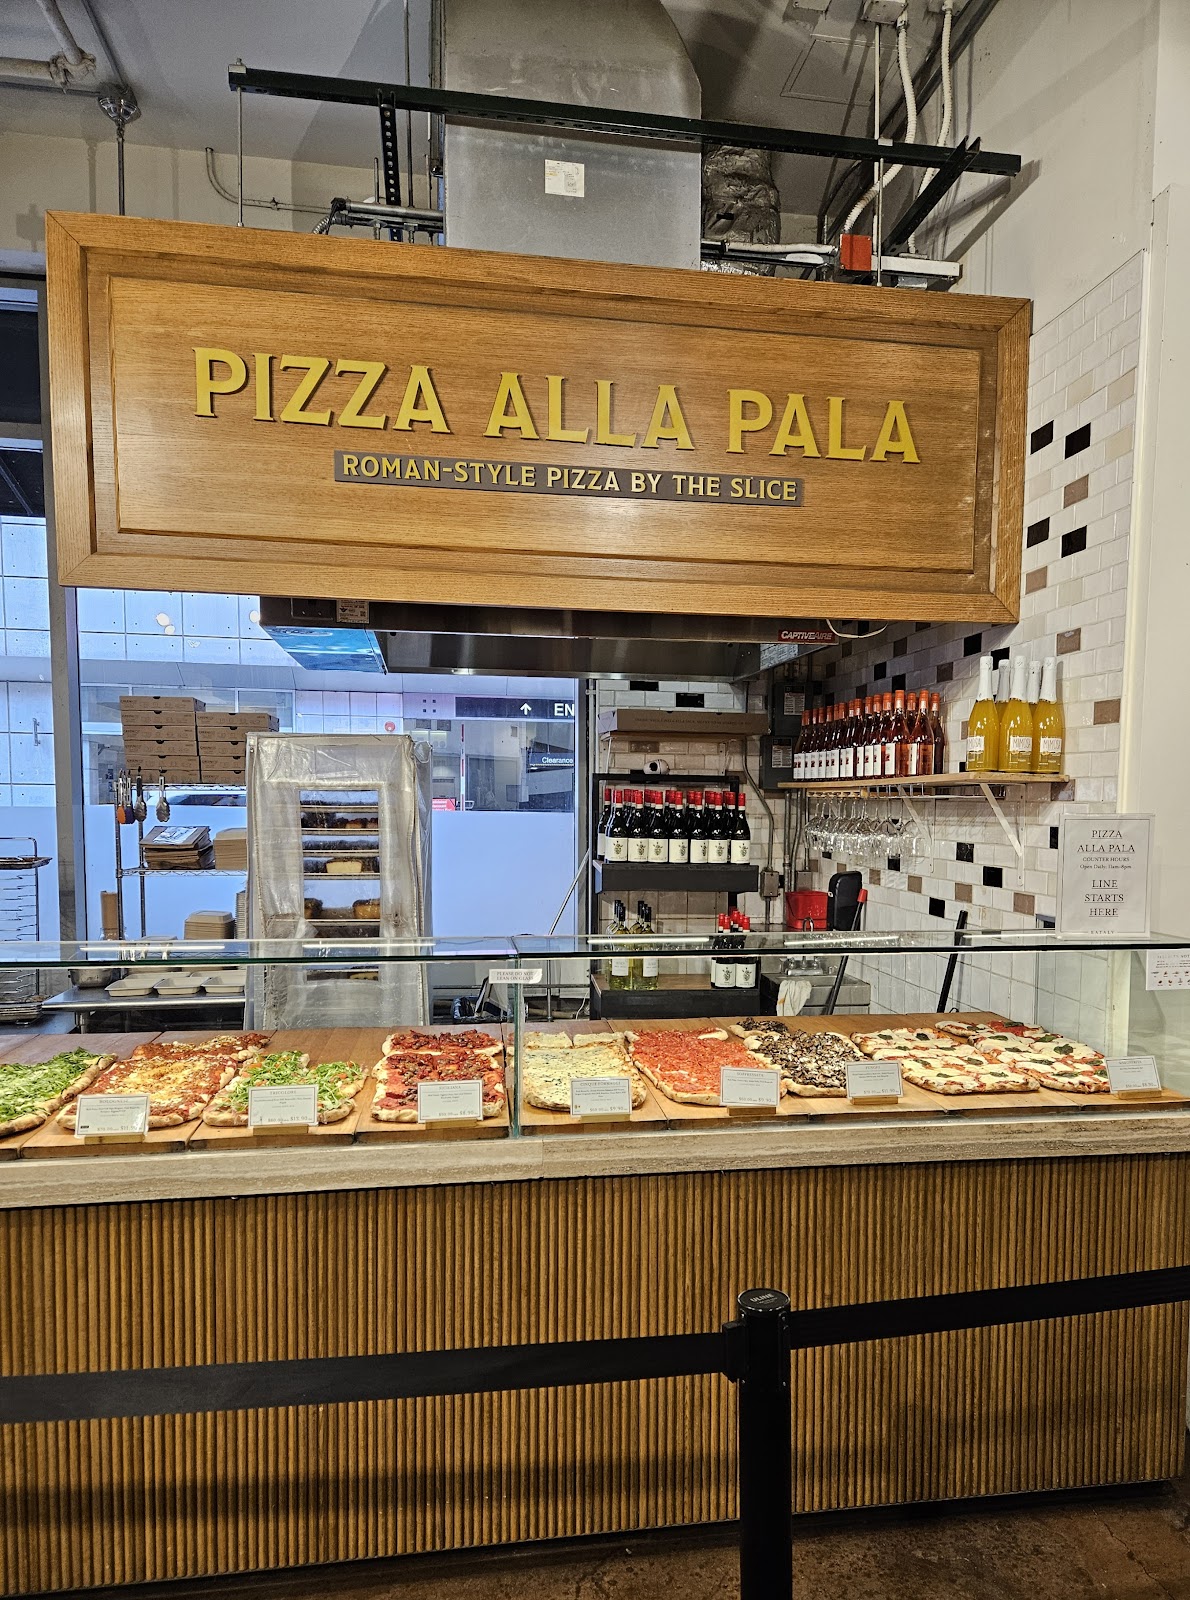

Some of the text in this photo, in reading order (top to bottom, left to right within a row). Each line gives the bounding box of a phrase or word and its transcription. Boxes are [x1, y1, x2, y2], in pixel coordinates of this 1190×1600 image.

[193, 347, 921, 464] PIZZA ALLA PALA
[342, 453, 798, 502] ROMAN-STYLE PIZZA BY THE SLICE
[541, 756, 574, 764] Clearance
[1091, 830, 1123, 838] PIZZA
[1077, 844, 1136, 853] ALLA PALA
[1091, 880, 1118, 888] LINE
[1084, 894, 1125, 902] STARTS
[1089, 908, 1119, 916] HERE
